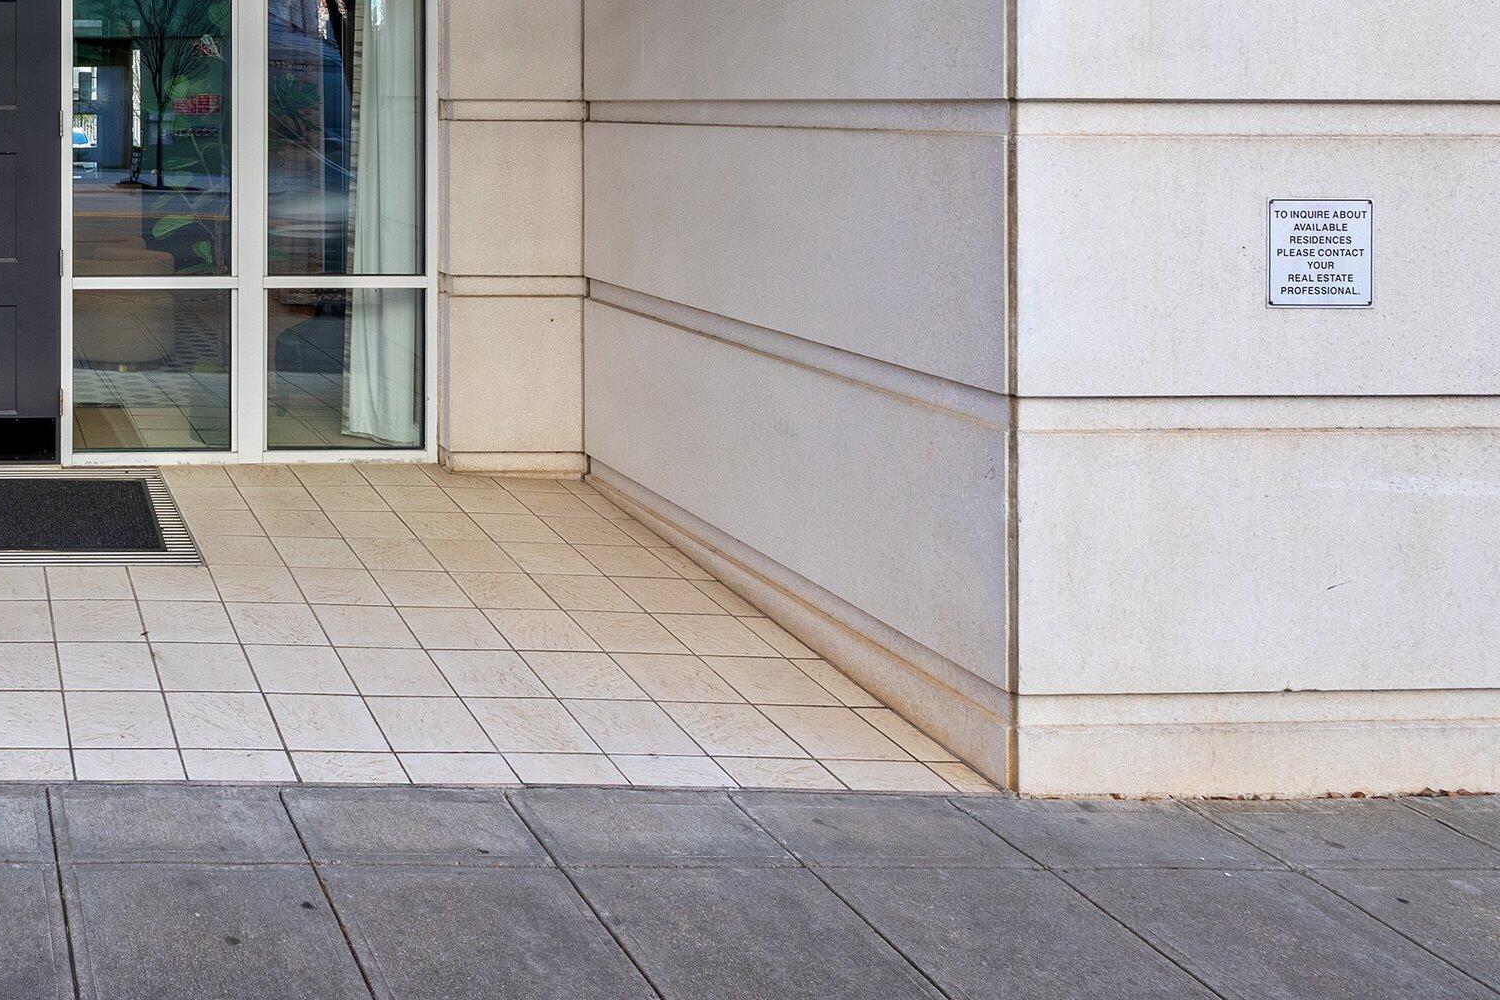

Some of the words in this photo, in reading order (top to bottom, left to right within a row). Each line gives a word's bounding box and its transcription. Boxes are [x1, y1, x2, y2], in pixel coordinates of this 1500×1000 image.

[1274, 210, 1288, 219] TO
[1290, 210, 1330, 219] INQUIRE
[1332, 210, 1367, 219] ABOUT
[1293, 223, 1348, 232] AVAILABLE
[1289, 236, 1352, 244] RESIDENCES
[1276, 248, 1316, 257] PLEASE
[1317, 248, 1365, 257] CONTACT
[1307, 261, 1335, 270] YOUR
[1287, 274, 1314, 282] REAL
[1316, 274, 1354, 282] ESTATE
[1280, 286, 1361, 295] PROFESSIONAL.
